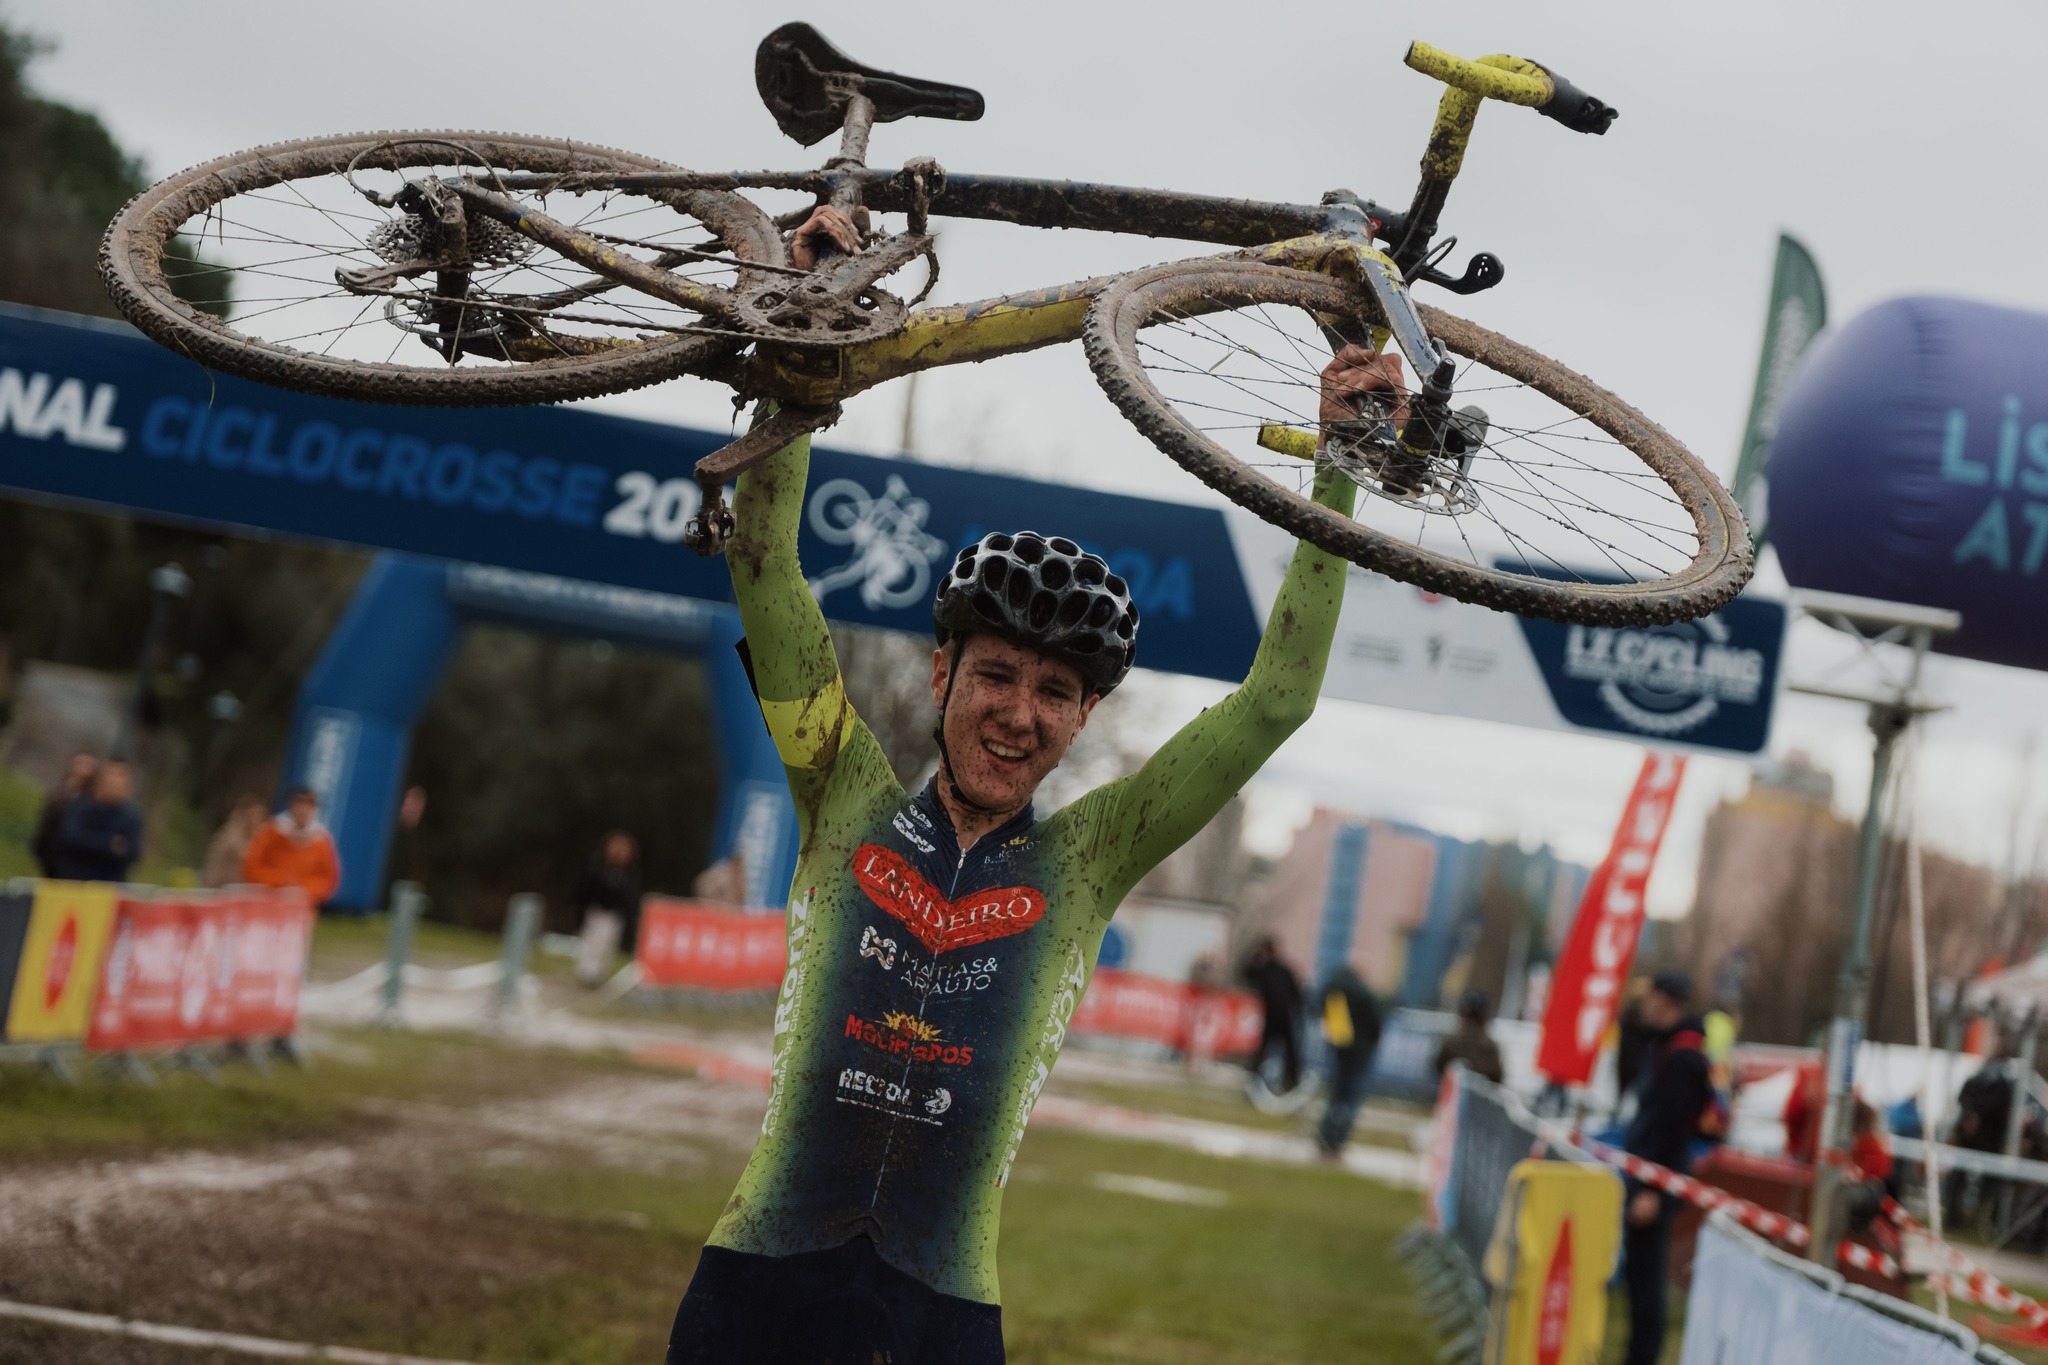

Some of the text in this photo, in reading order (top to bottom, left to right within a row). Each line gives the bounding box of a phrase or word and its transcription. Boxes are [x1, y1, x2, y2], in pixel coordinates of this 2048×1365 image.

[140, 396, 608, 526] CICLOCROSSE
[863, 850, 1031, 932] LANDEIRO
[1046, 942, 1079, 1028] ACADEMIA
[767, 961, 807, 1137] ACADEMIA DE CICLISMO
[1015, 1055, 1041, 1123] CICLISMO
